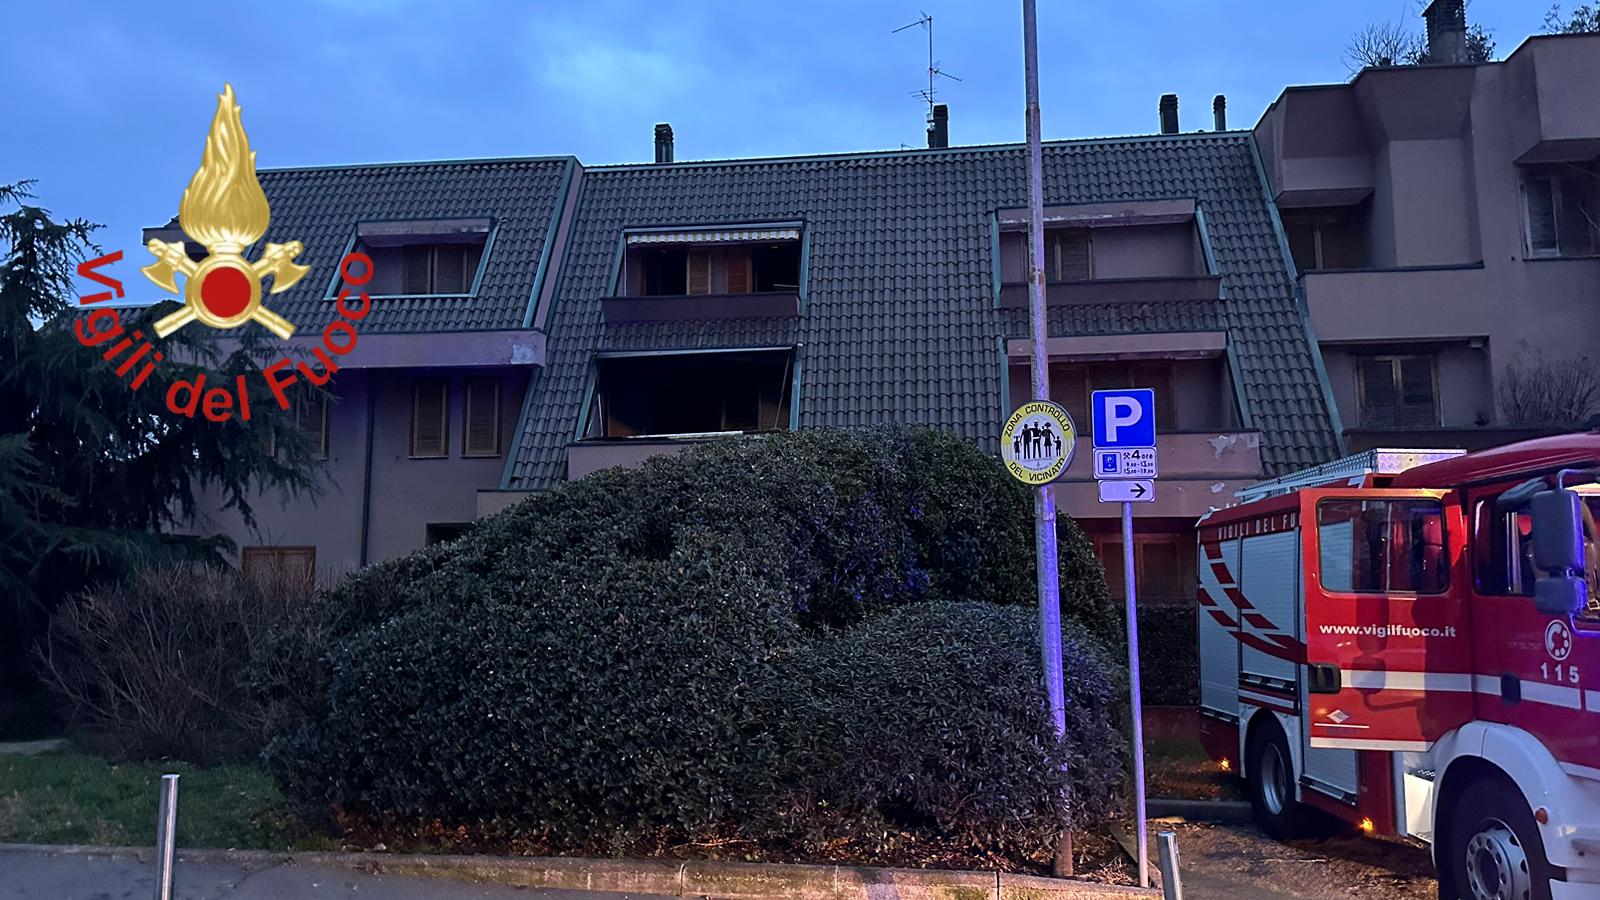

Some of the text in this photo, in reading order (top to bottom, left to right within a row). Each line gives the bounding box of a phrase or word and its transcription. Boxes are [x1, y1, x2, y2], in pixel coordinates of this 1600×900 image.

[1004, 404, 1070, 438] ZONA CONTROLLO
[1104, 396, 1143, 443] P
[1131, 450, 1141, 459] 4
[1009, 462, 1023, 478] DEL
[1218, 511, 1302, 540] VIGILI DEL FU
[1319, 624, 1457, 638] www.vigilfuoco.it
[1540, 662, 1580, 684] 115
